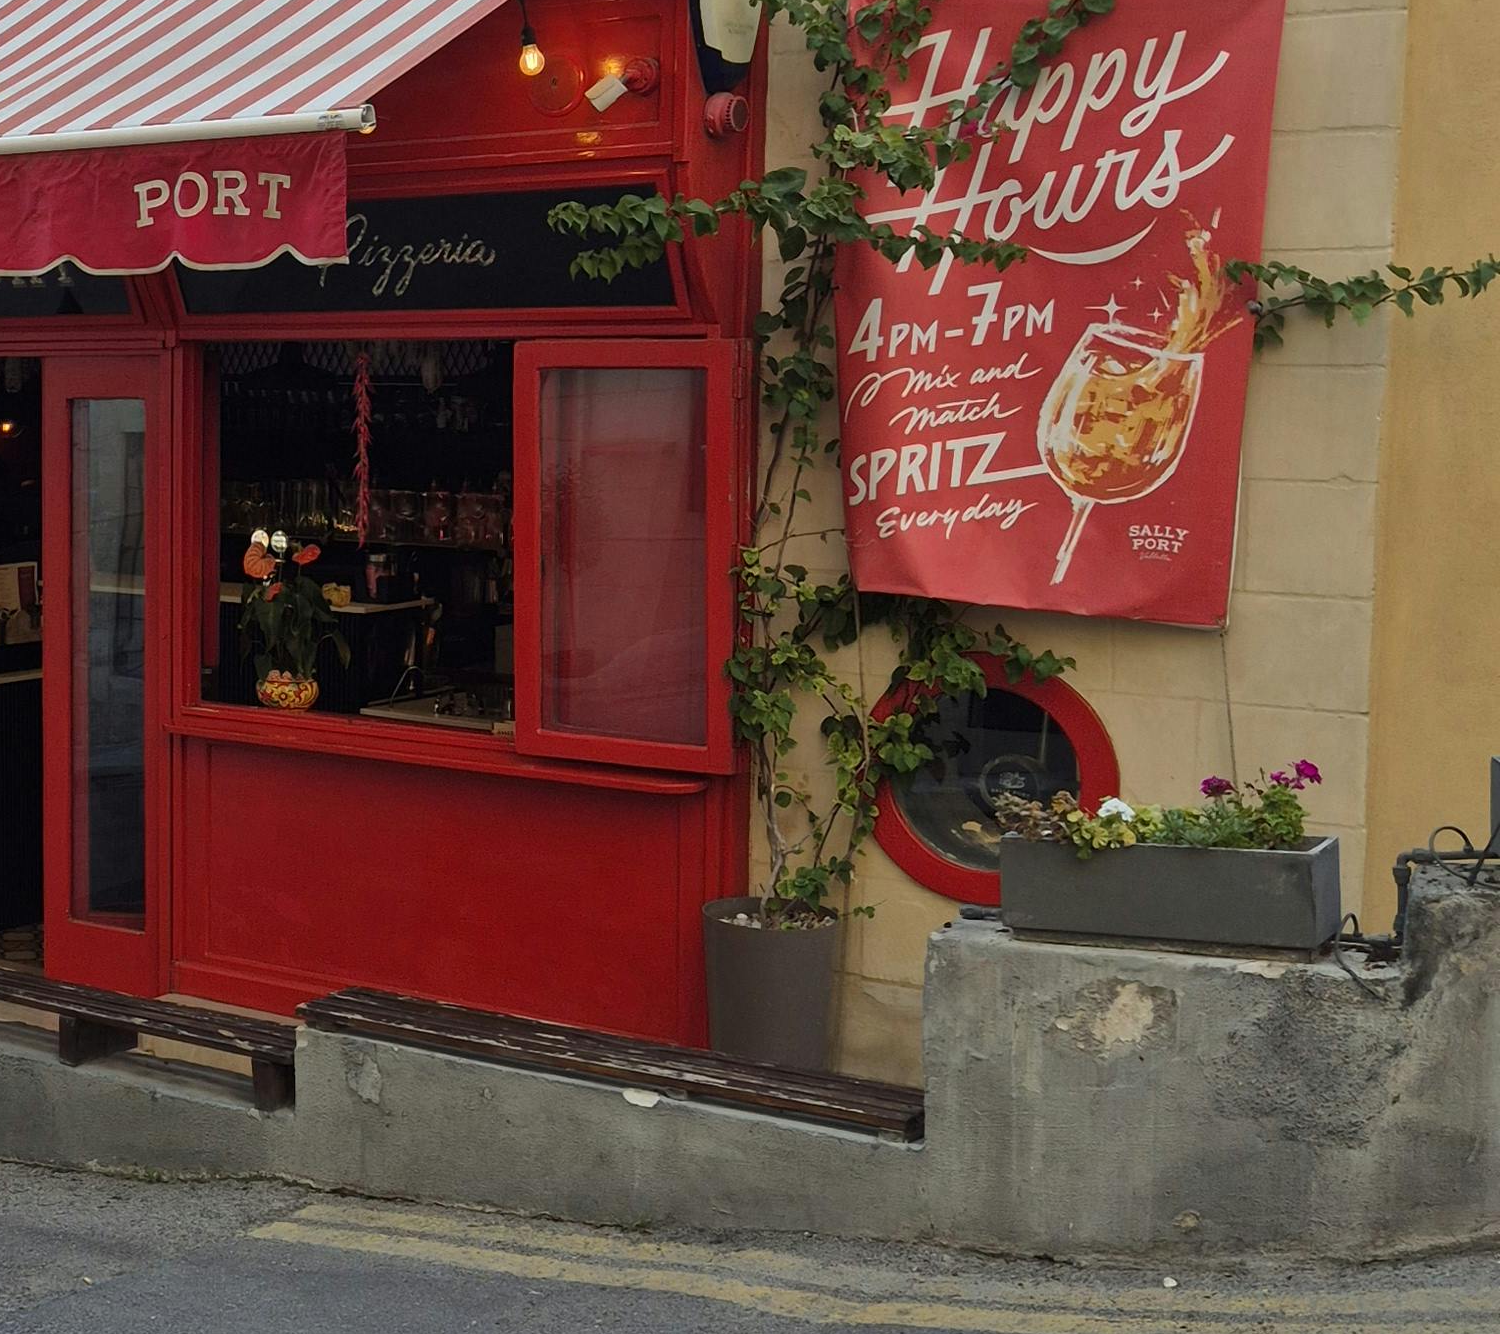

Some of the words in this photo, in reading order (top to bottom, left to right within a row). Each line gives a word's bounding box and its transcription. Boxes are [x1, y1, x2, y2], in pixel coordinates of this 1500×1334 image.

[877, 27, 1230, 163] Happy
[133, 169, 292, 228] PORT
[866, 129, 1235, 295] Hours
[845, 366, 958, 423] Mix
[969, 353, 1043, 386] and
[888, 392, 1023, 435] Match
[848, 431, 1050, 506] SPRITZ
[1129, 524, 1190, 541] SALLY
[1132, 537, 1183, 553] PORT
